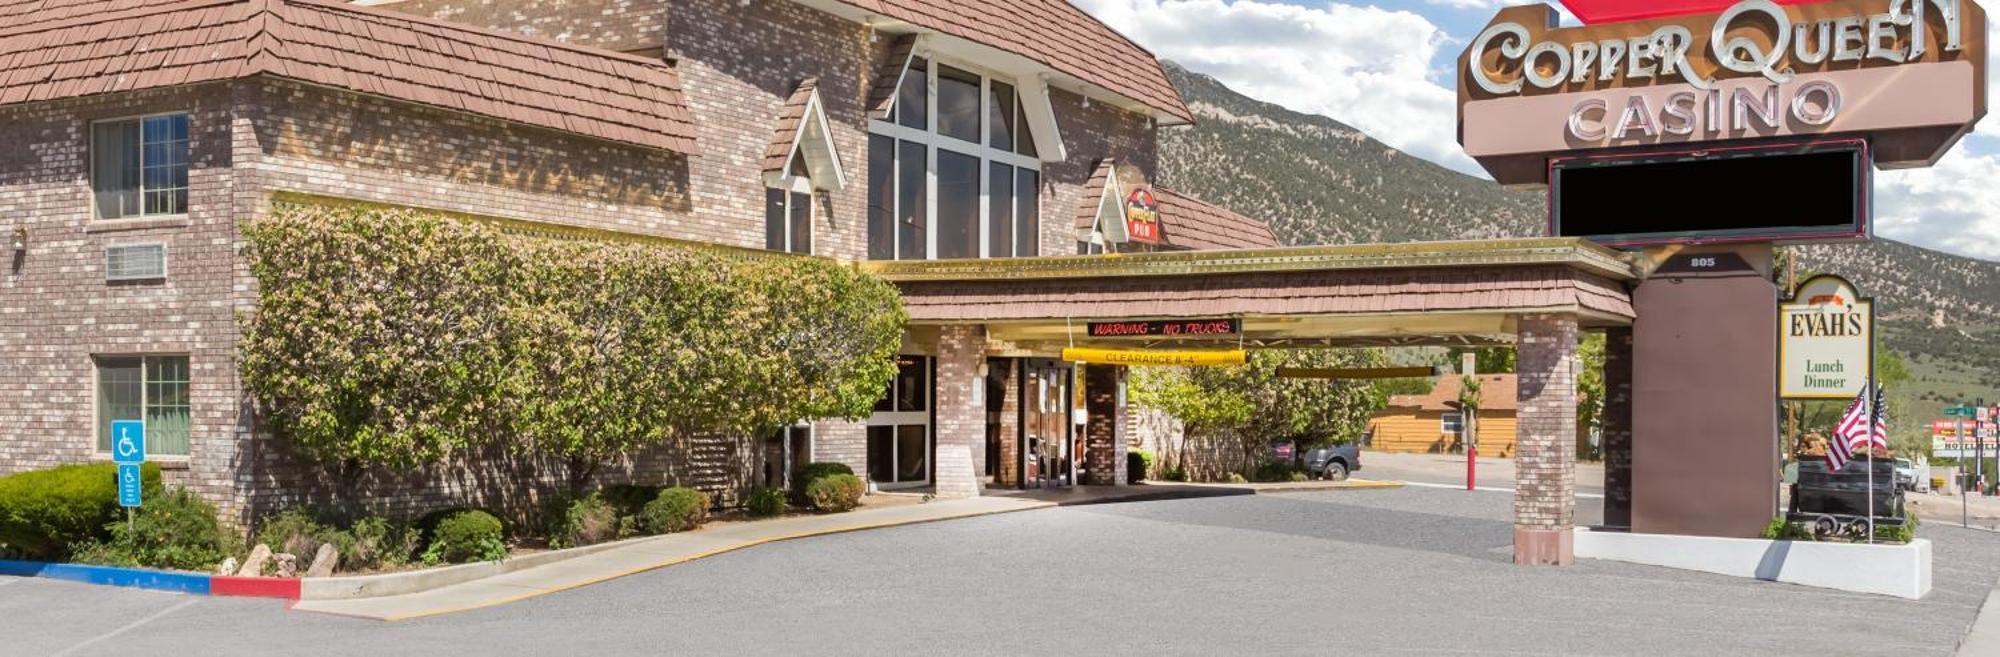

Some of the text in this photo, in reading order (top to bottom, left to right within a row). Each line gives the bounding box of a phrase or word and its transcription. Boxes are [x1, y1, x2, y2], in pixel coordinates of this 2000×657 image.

[1568, 79, 1842, 141] CASINO
[1690, 257, 1715, 268] 805
[1790, 304, 1863, 337] EVAH'S
[1094, 322, 1149, 335] WARNING
[1163, 323, 1181, 336] NO
[1184, 320, 1231, 334] TRUCKS
[1105, 352, 1173, 364] CLEARANCE
[1806, 359, 1844, 373] Lunch
[1804, 374, 1846, 388] Dinner
